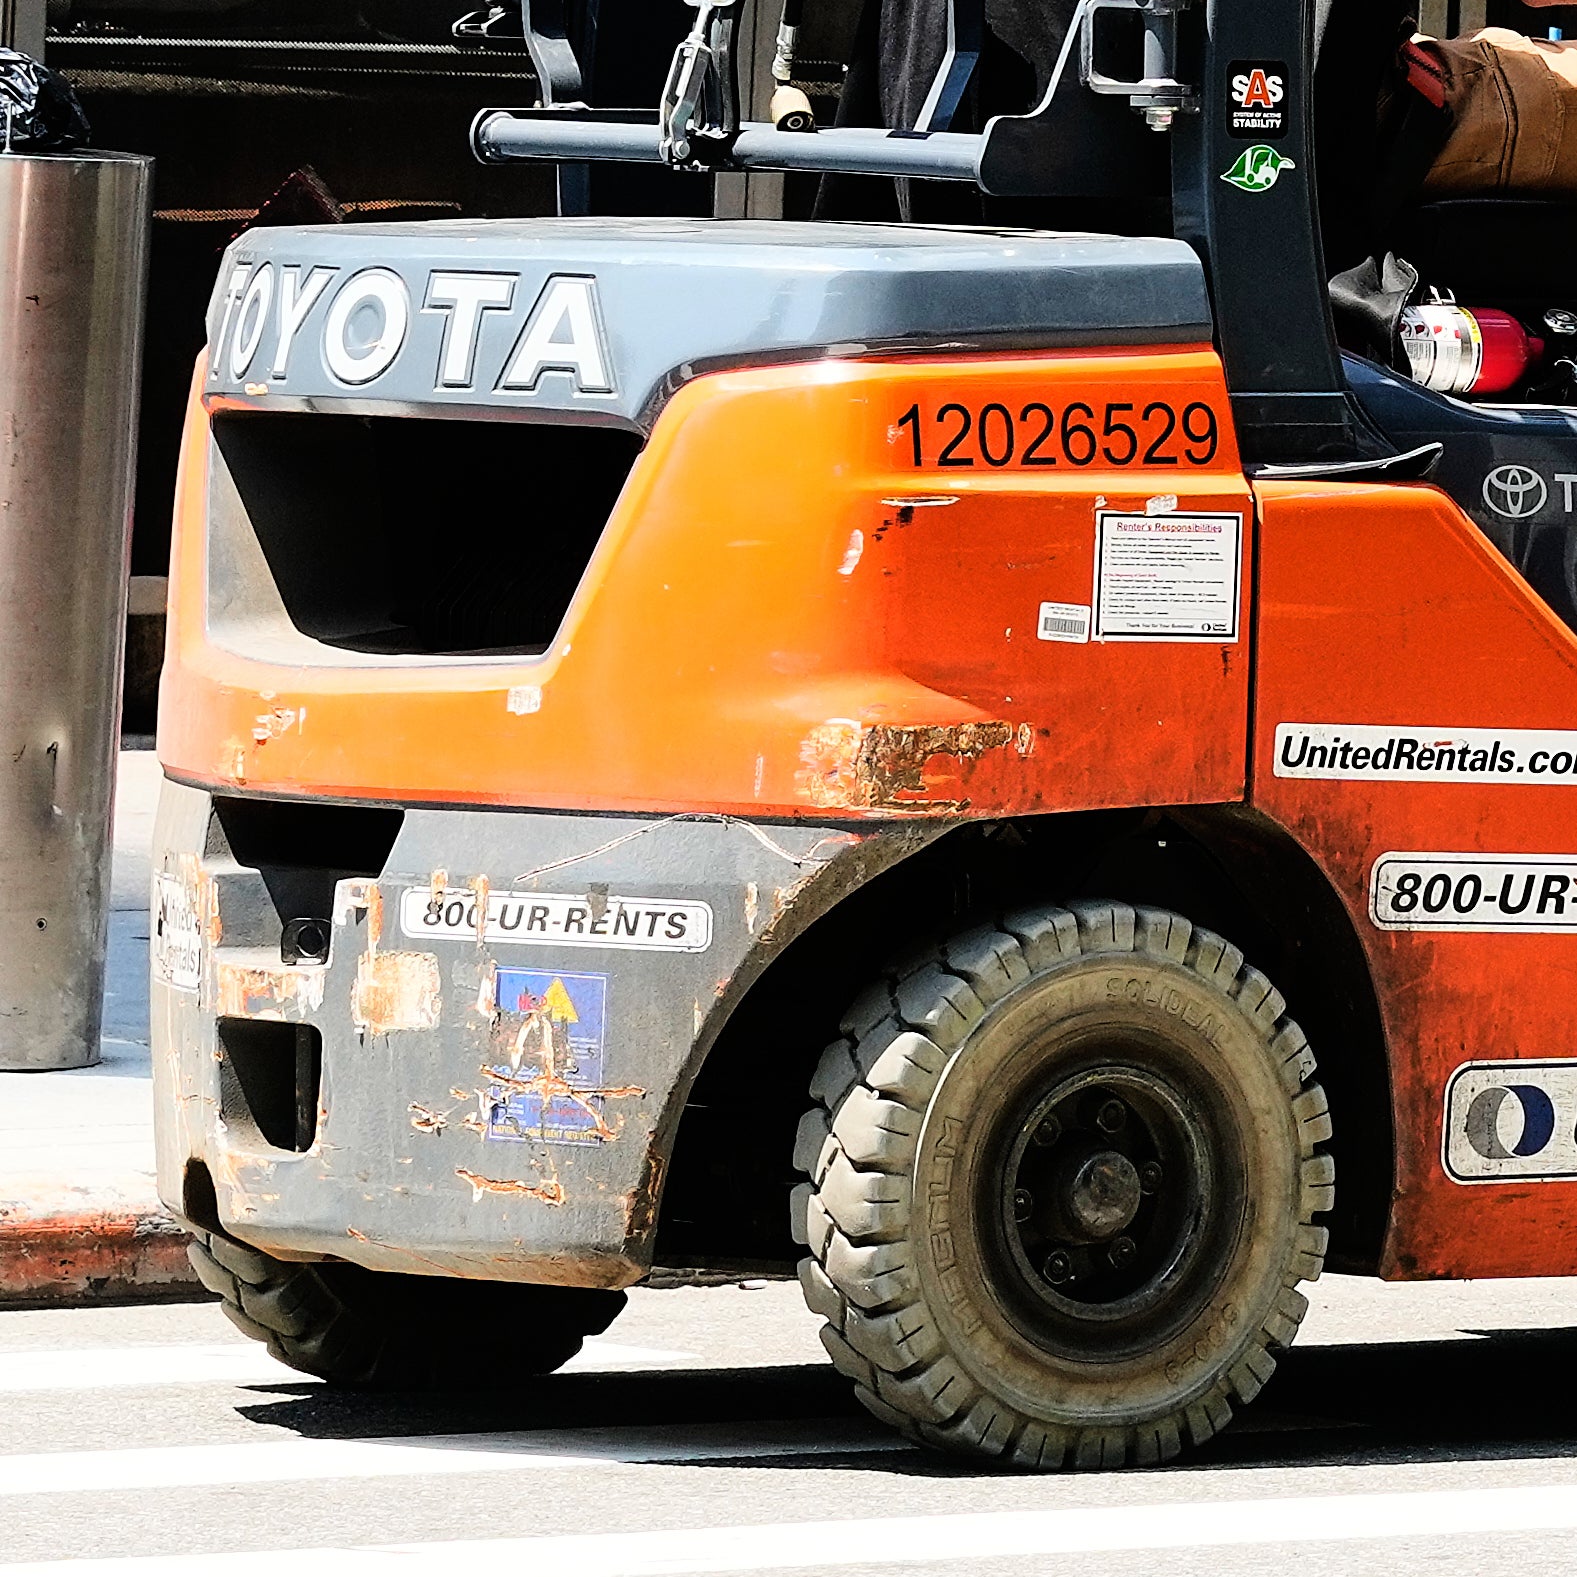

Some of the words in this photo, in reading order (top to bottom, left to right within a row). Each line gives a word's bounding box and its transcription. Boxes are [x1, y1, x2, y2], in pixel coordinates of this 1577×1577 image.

[1231, 69, 1284, 109] SAS
[1233, 118, 1282, 128] STABILITY
[211, 262, 620, 400] TOYOTA
[896, 400, 1219, 469] 12026529
[1155, 522, 1222, 533] Responsibilities
